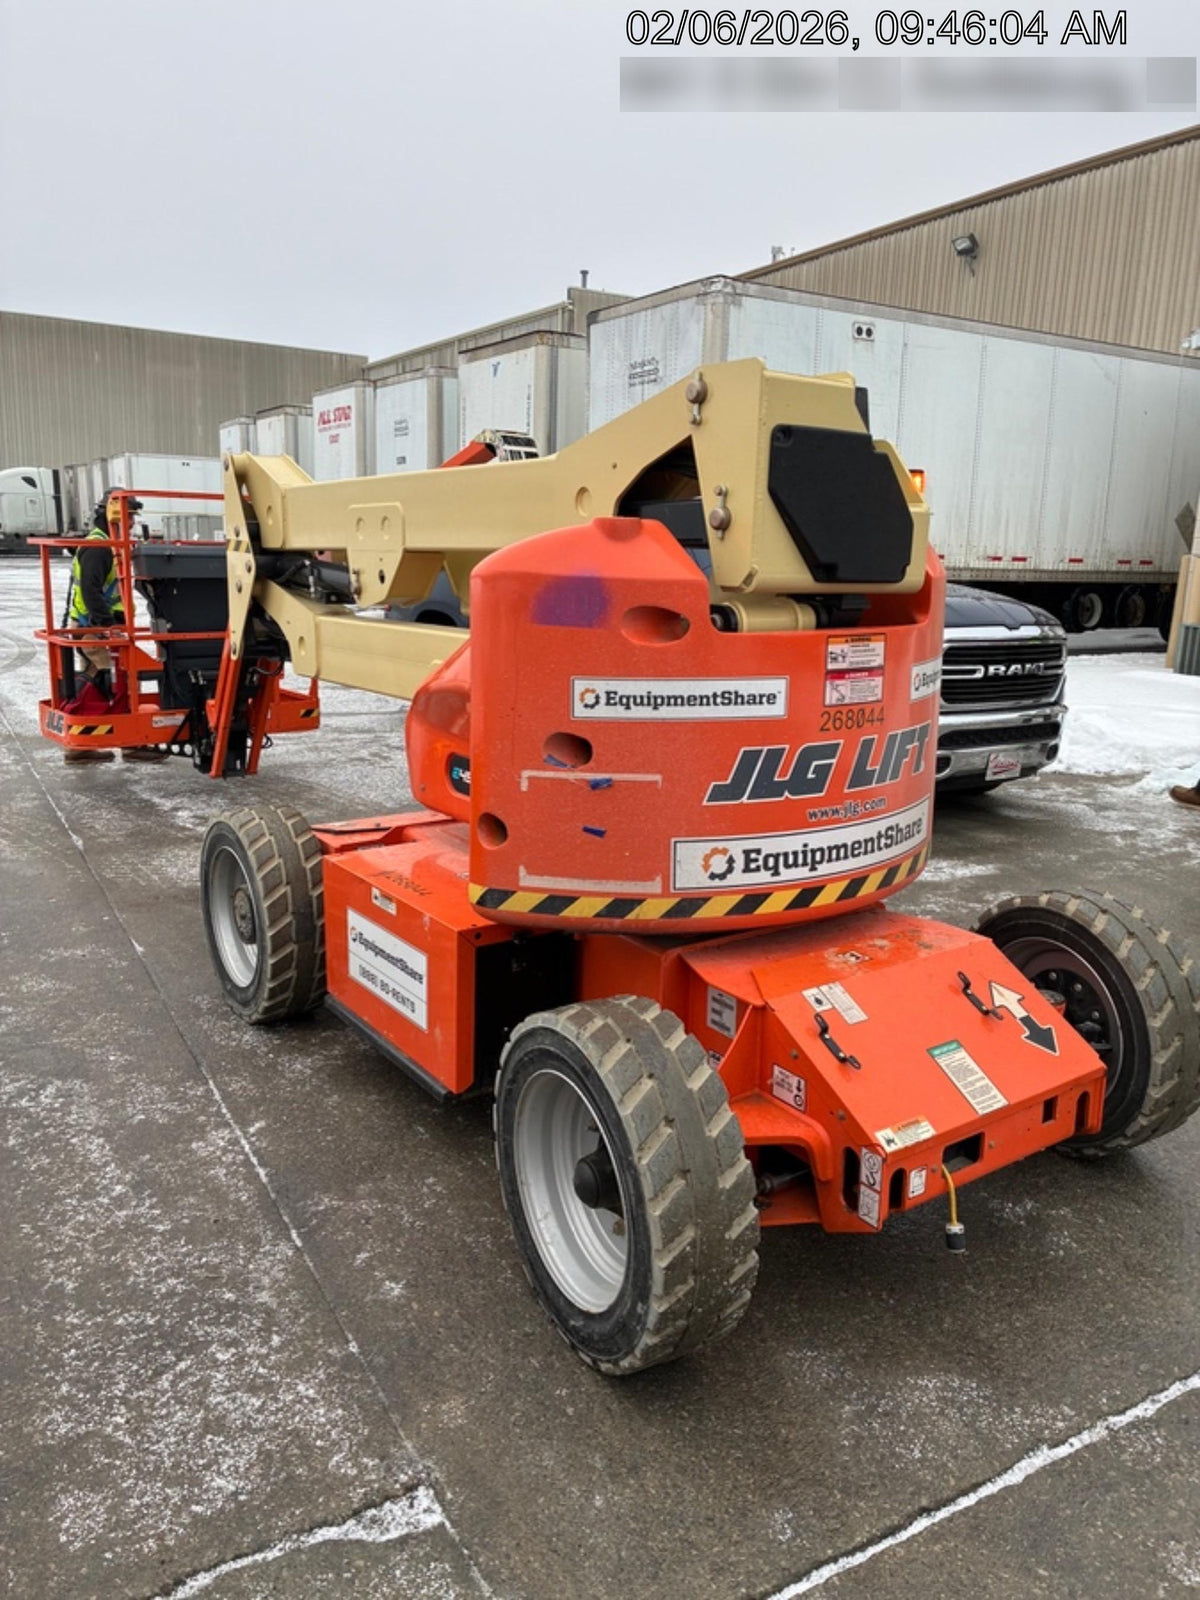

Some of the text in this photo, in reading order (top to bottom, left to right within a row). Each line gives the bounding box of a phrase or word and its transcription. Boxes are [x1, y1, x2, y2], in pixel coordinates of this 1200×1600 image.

[987, 662, 1045, 677] RAM
[604, 690, 778, 710] EquipmentShare
[819, 705, 885, 732] 268044
[702, 720, 931, 805] JLG LIFT
[807, 796, 887, 822] www.jlg.com
[742, 817, 924, 877] EquipmentShare
